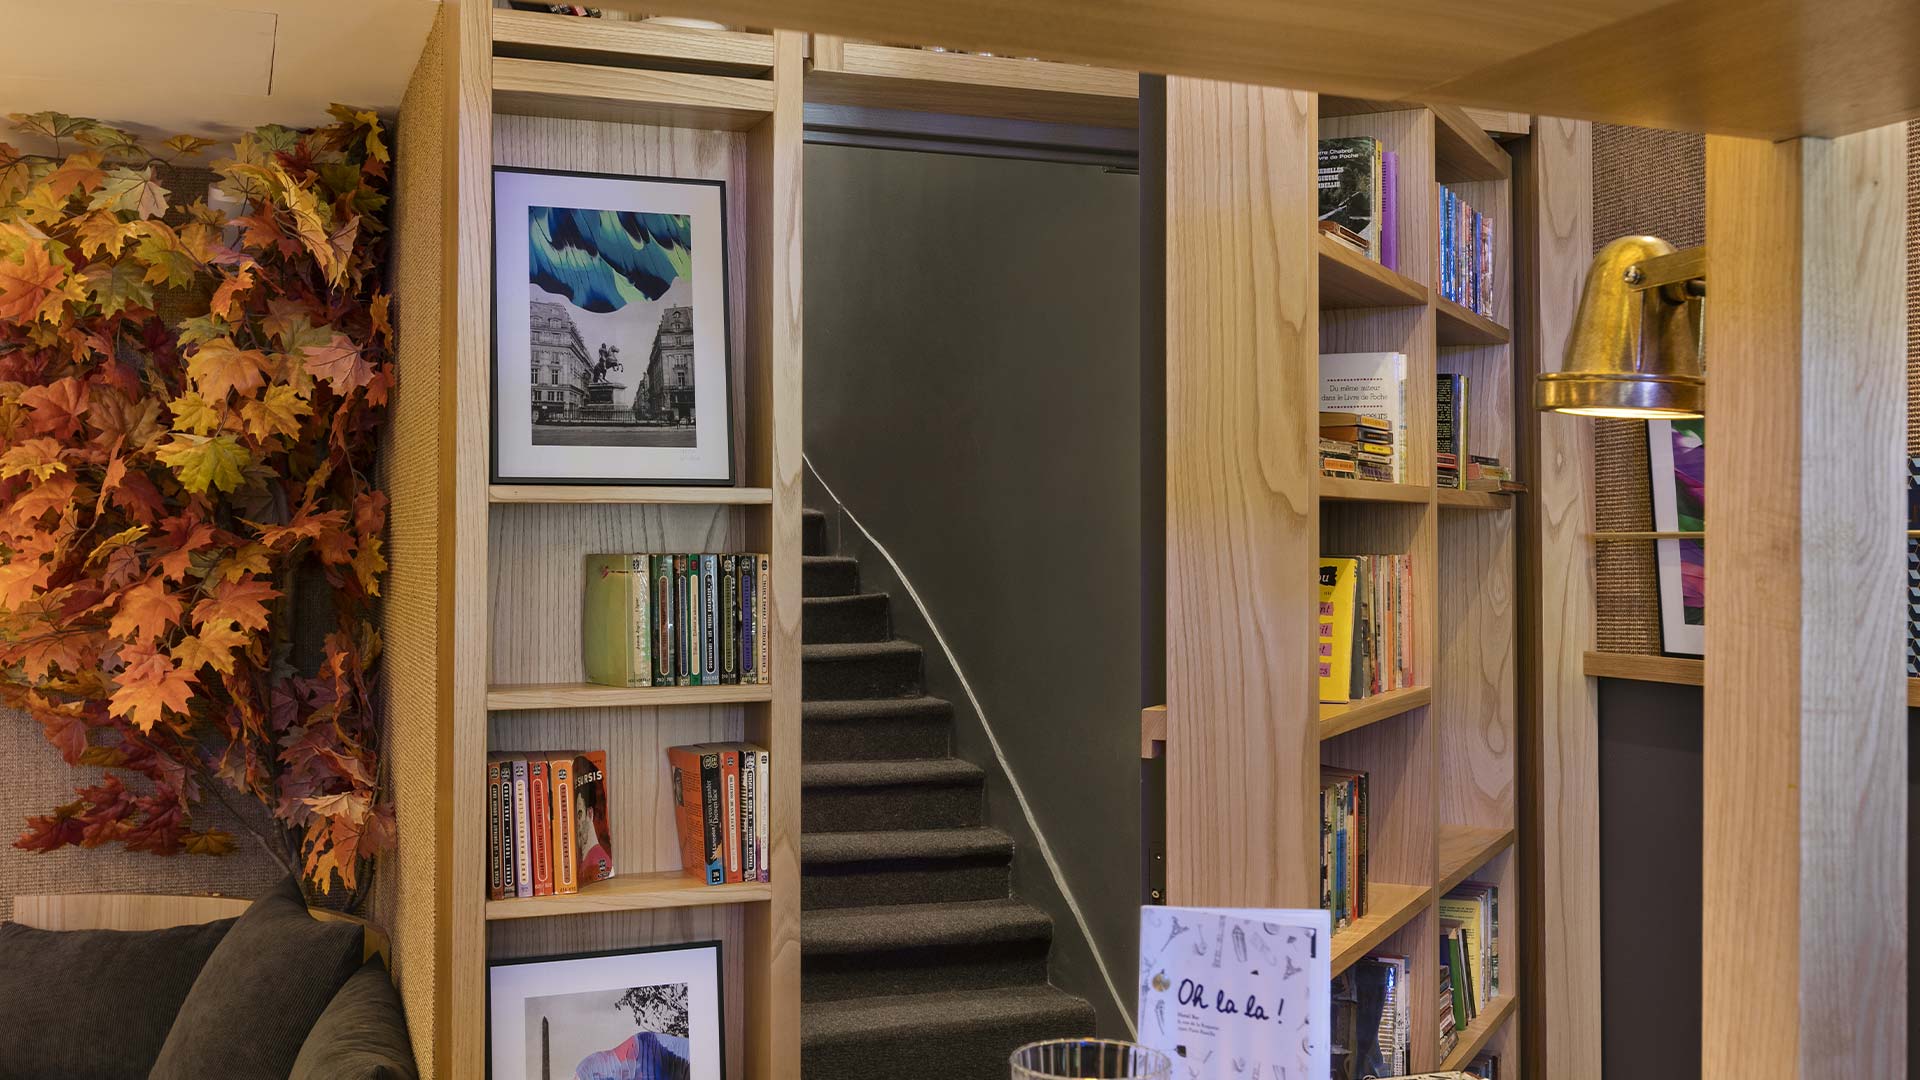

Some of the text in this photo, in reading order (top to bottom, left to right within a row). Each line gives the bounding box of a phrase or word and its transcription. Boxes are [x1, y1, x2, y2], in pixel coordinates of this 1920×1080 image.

[578, 770, 602, 786] SURSIS
[1178, 978, 1284, 1024] Oh la la !
